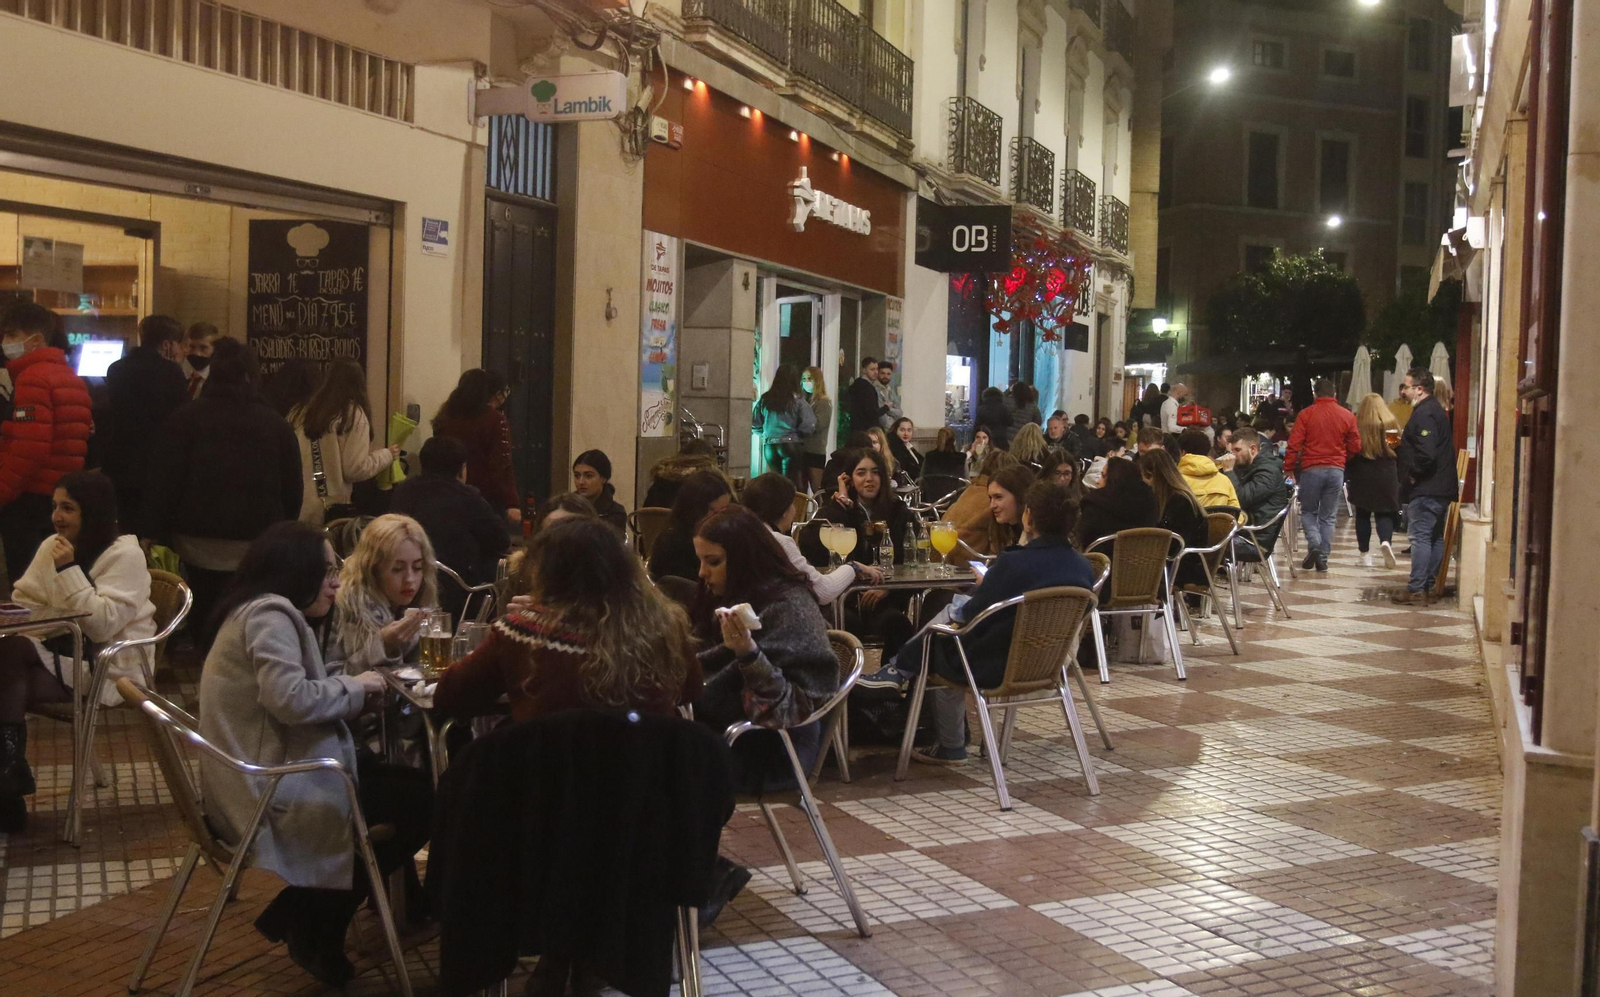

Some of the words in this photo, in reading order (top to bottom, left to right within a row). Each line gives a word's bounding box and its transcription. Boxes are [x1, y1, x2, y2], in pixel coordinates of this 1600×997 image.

[553, 96, 612, 115] Lambik
[952, 225, 989, 252] OB
[250, 273, 280, 294] JARRA
[287, 273, 299, 294] 1€
[317, 268, 350, 290] TAPAS
[351, 267, 364, 292] 1€
[646, 278, 673, 295] MOJITOS
